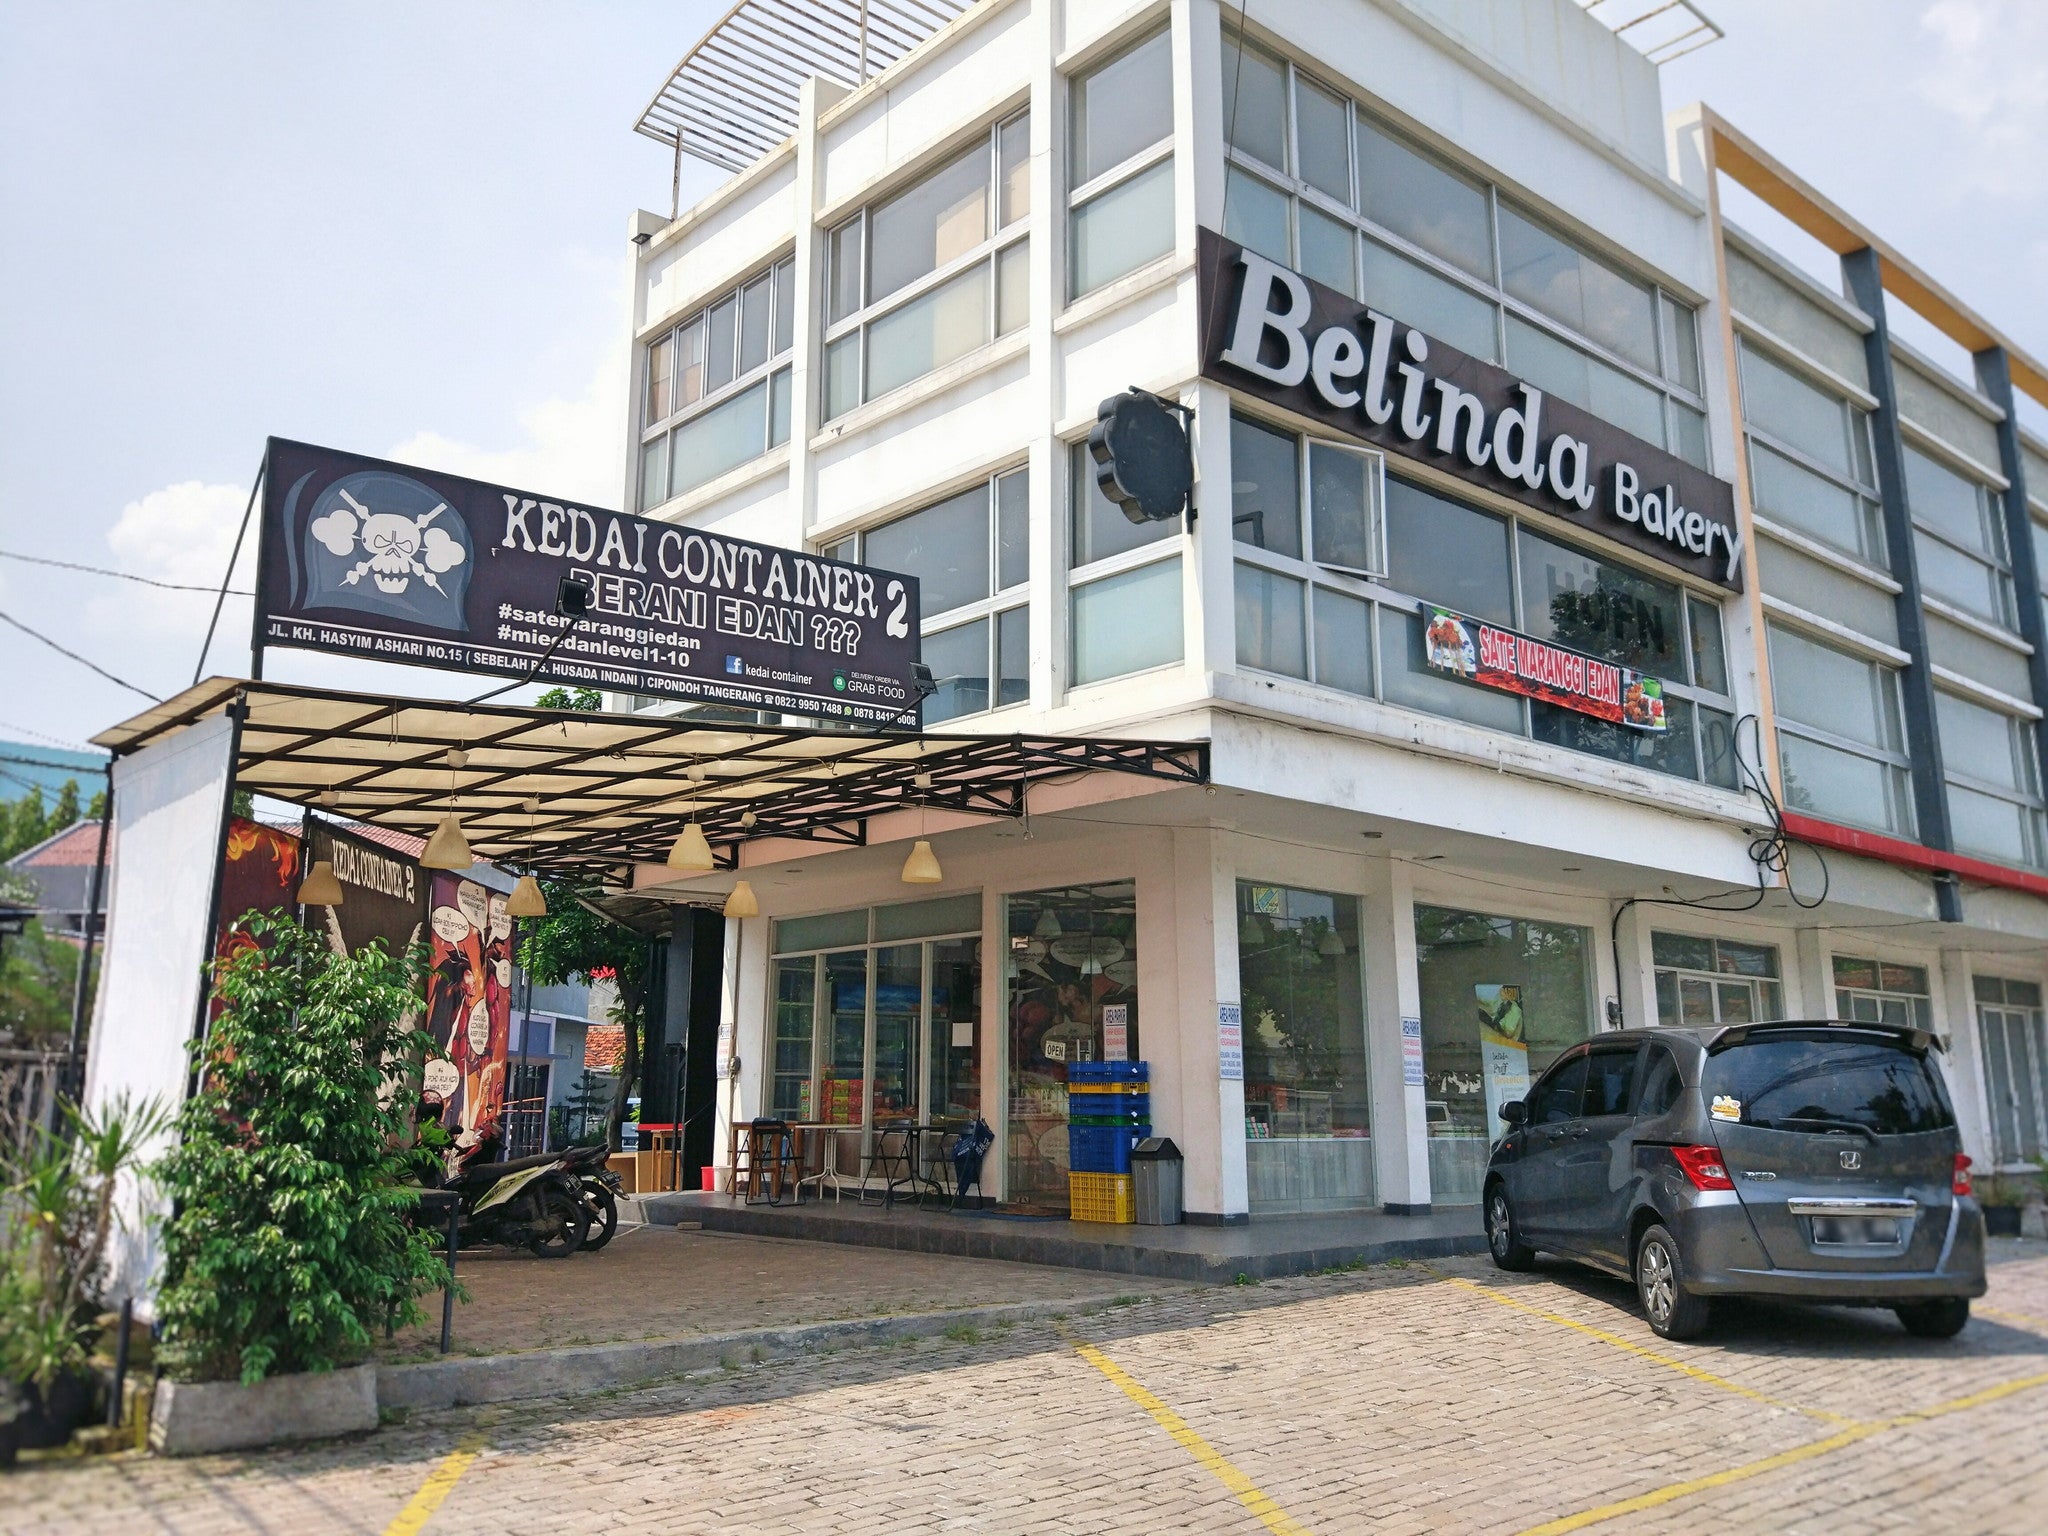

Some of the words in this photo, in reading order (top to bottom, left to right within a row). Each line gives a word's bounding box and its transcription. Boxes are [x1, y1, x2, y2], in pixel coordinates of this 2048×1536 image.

[1220, 248, 1597, 511] Belinda
[1613, 462, 1744, 581] Bakery
[502, 494, 648, 574] KEDAI
[657, 530, 879, 619] CONTAINER
[886, 580, 909, 639] 2
[498, 603, 701, 650] #satemaranggiedan
[715, 596, 804, 646] EDAN
[268, 623, 289, 637] JL.
[292, 626, 316, 641] KH.
[320, 630, 372, 649] HASYIM
[375, 638, 423, 656] ASHARI
[426, 645, 463, 661] NO.15
[473, 652, 528, 671] SEBELAH
[552, 663, 598, 680] HUSADA
[601, 670, 638, 686] INDANI
[647, 677, 700, 694] CIPONDOH
[703, 685, 762, 703] TANGERANG
[775, 695, 796, 709] 0822
[798, 698, 820, 711] 9950
[821, 702, 842, 715] 7488
[853, 707, 874, 719] 0878
[745, 664, 770, 679] kedai
[771, 670, 813, 685] container
[848, 680, 876, 695] GRAB
[878, 685, 905, 699] FOOD
[851, 672, 875, 681] DELIVERY
[875, 675, 891, 684] ORDER
[1478, 625, 1517, 674] SATE
[1516, 638, 1585, 695] MARANGGI
[1587, 662, 1620, 705] EDAN
[332, 839, 360, 886] KEDAI
[360, 850, 404, 899] CONTAINER
[405, 865, 415, 904] 2
[1047, 1045, 1064, 1057] OPEN
